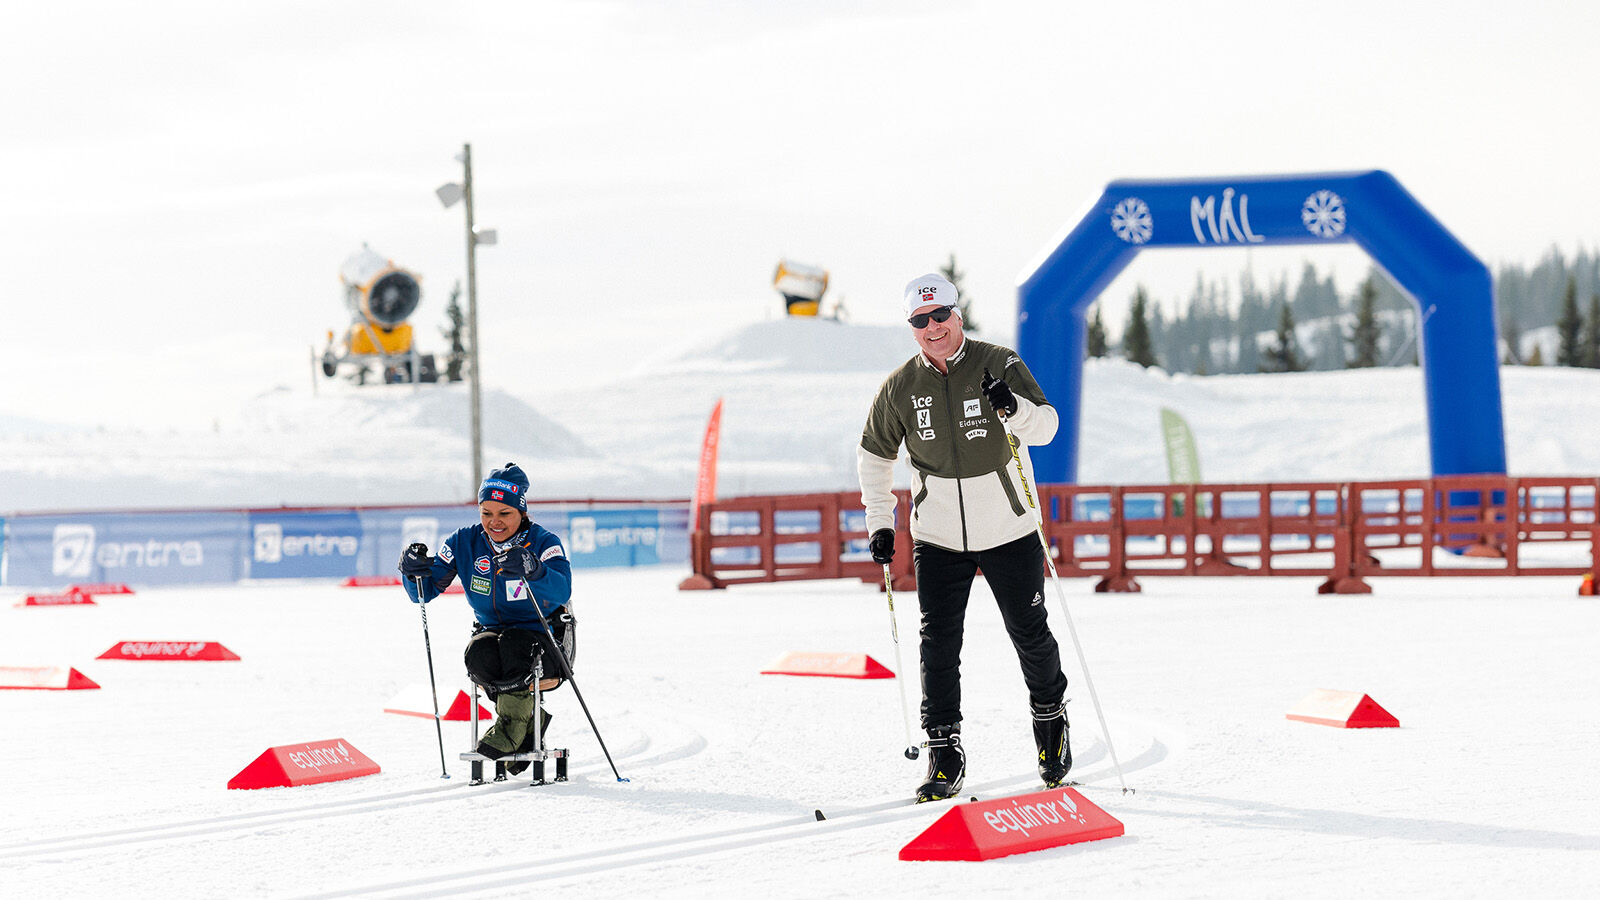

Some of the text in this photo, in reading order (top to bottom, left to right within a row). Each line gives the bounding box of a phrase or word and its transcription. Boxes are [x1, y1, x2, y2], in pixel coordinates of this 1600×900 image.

[1190, 187, 1265, 242] MÅL
[918, 286, 937, 295] ice
[911, 395, 933, 409] ice
[966, 404, 979, 412] AF
[916, 429, 936, 441] VB
[967, 430, 985, 438] MENY
[281, 533, 357, 556] entra
[596, 527, 656, 547] entra
[97, 540, 203, 567] entra
[121, 642, 187, 658] equinor
[289, 745, 342, 773] equinor
[983, 801, 1065, 837] equinor
